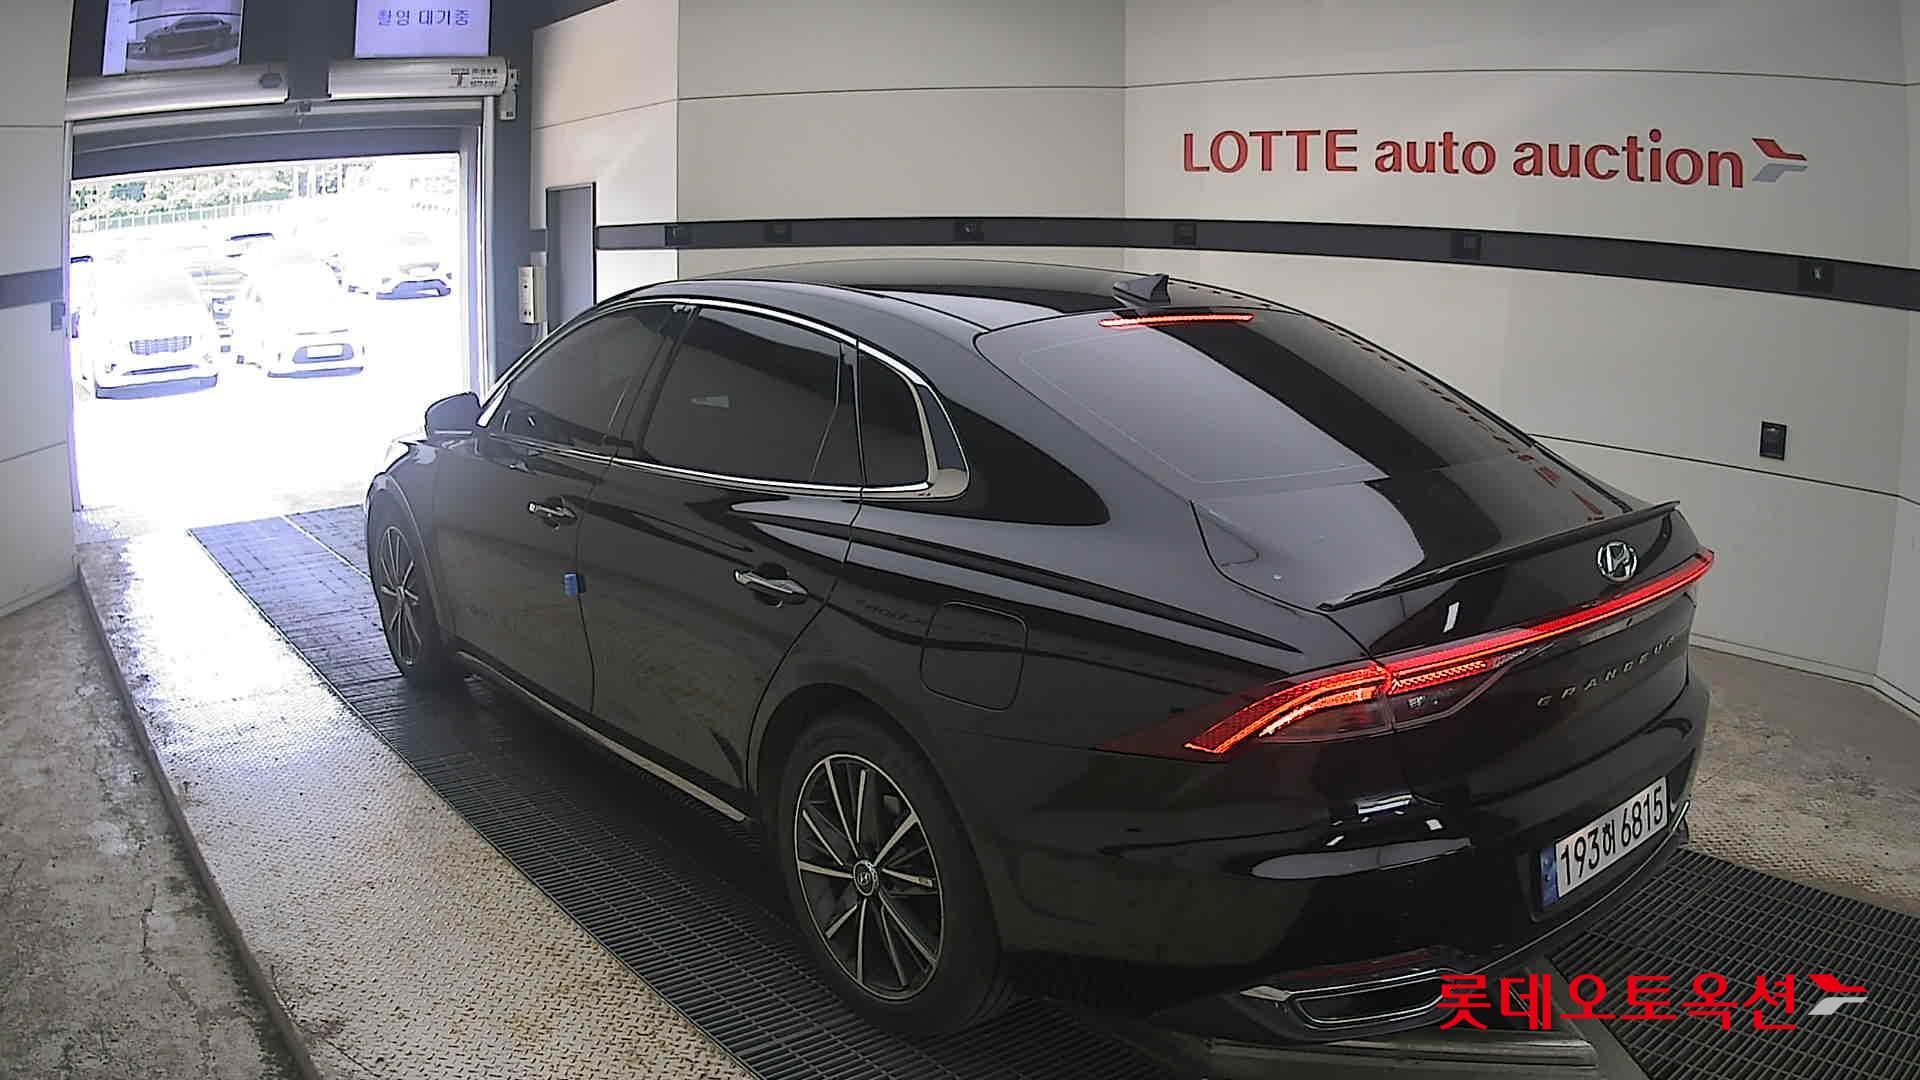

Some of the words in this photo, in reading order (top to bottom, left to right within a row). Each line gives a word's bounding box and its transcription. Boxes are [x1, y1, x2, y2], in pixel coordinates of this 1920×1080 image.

[418, 9, 470, 26] 대기중
[1183, 128, 1358, 173] LOTTE
[1374, 131, 1497, 176] auto
[1512, 128, 1745, 188] auction
[1560, 818, 1616, 886] 193허
[1620, 786, 1664, 847] 6815
